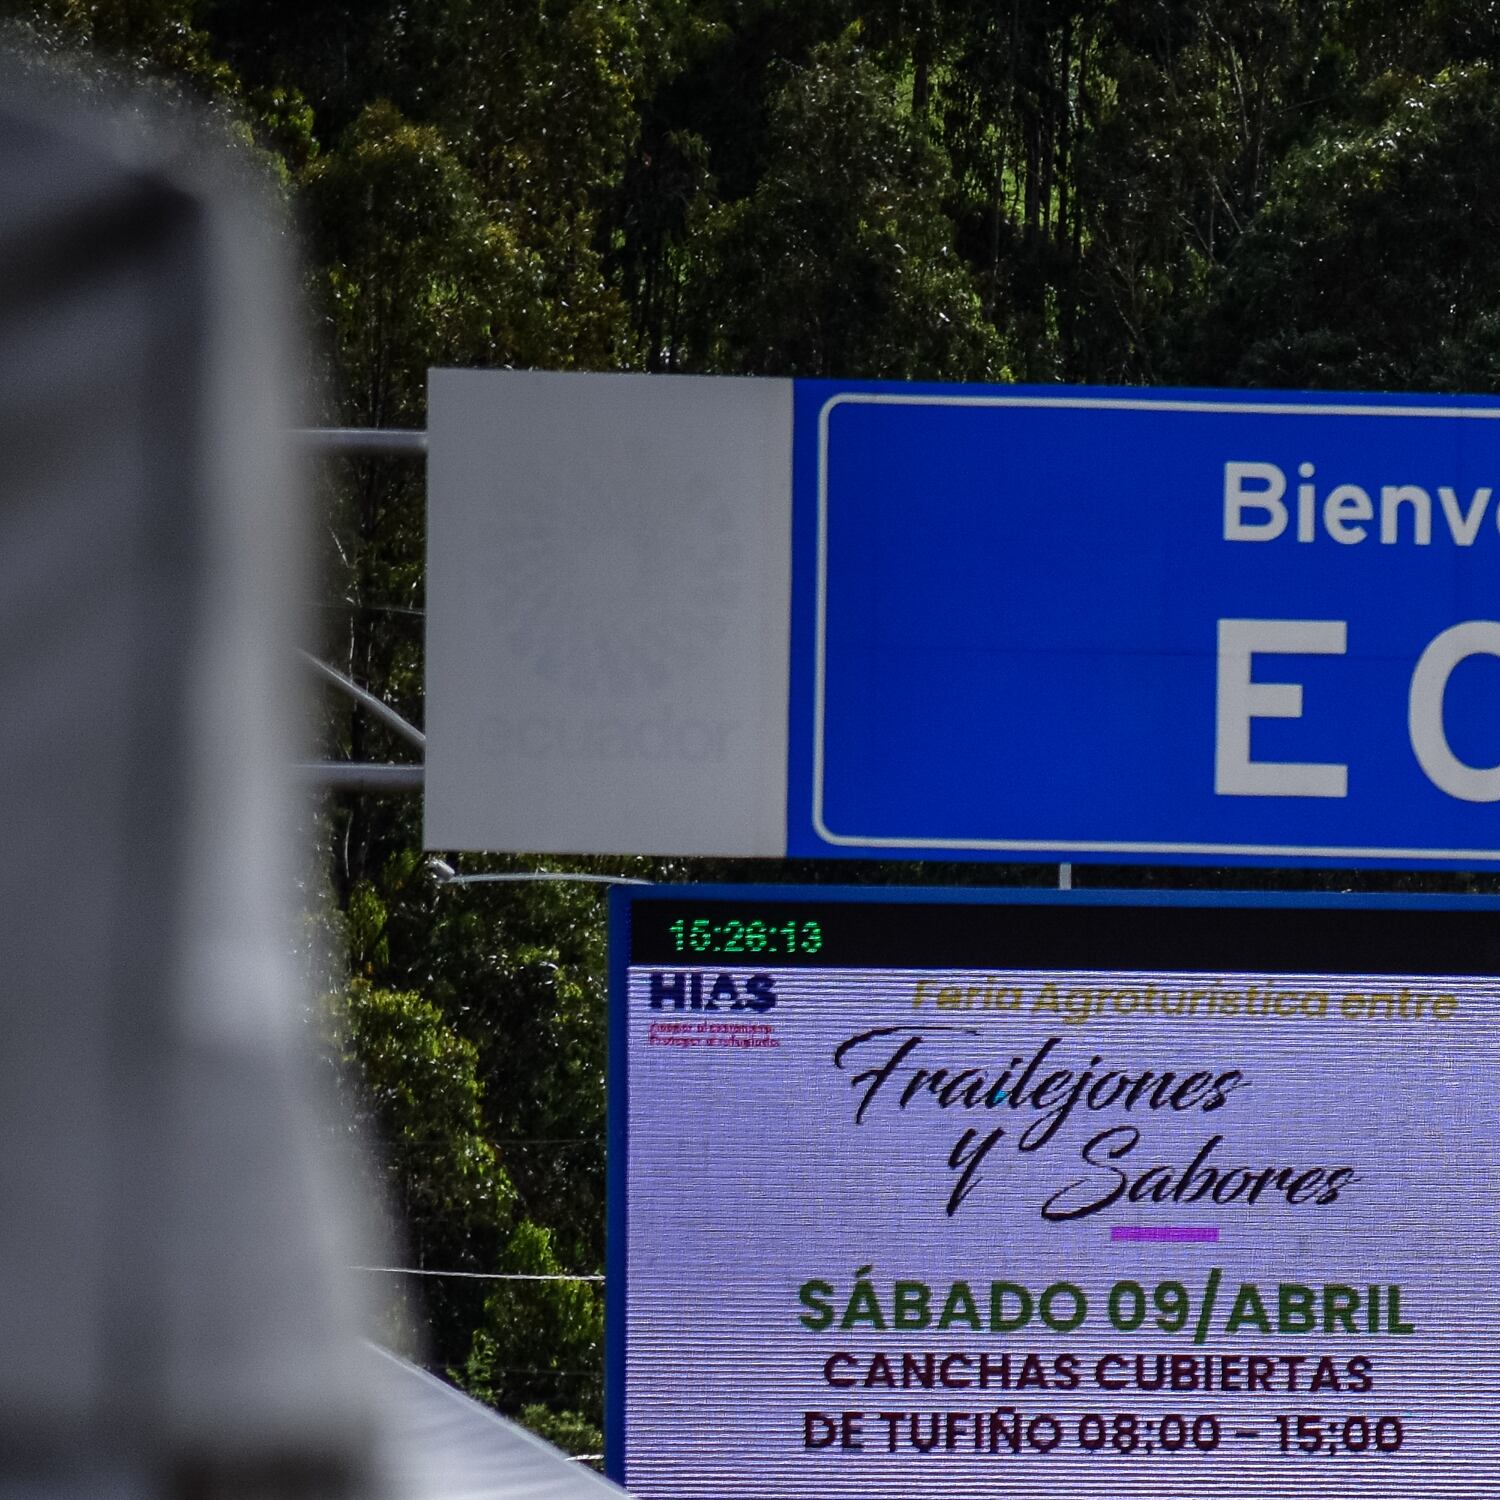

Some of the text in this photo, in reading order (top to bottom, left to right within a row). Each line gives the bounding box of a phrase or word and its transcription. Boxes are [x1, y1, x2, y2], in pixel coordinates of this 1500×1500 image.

[648, 971, 778, 1012] HIAS
[1340, 986, 1460, 1020] entre
[833, 1025, 1253, 1151] Frailejones
[1040, 1125, 1361, 1221] Sabores
[798, 1265, 1415, 1345] SÁBADO 09/ABRIL
[822, 1352, 1373, 1393] CANCHAS CUBIERTAS
[803, 1412, 864, 1450] DE
[880, 1407, 1062, 1454] TUFIÑO
[1078, 1413, 1221, 1454] 08:00
[1276, 1415, 1405, 1455] 15:00
